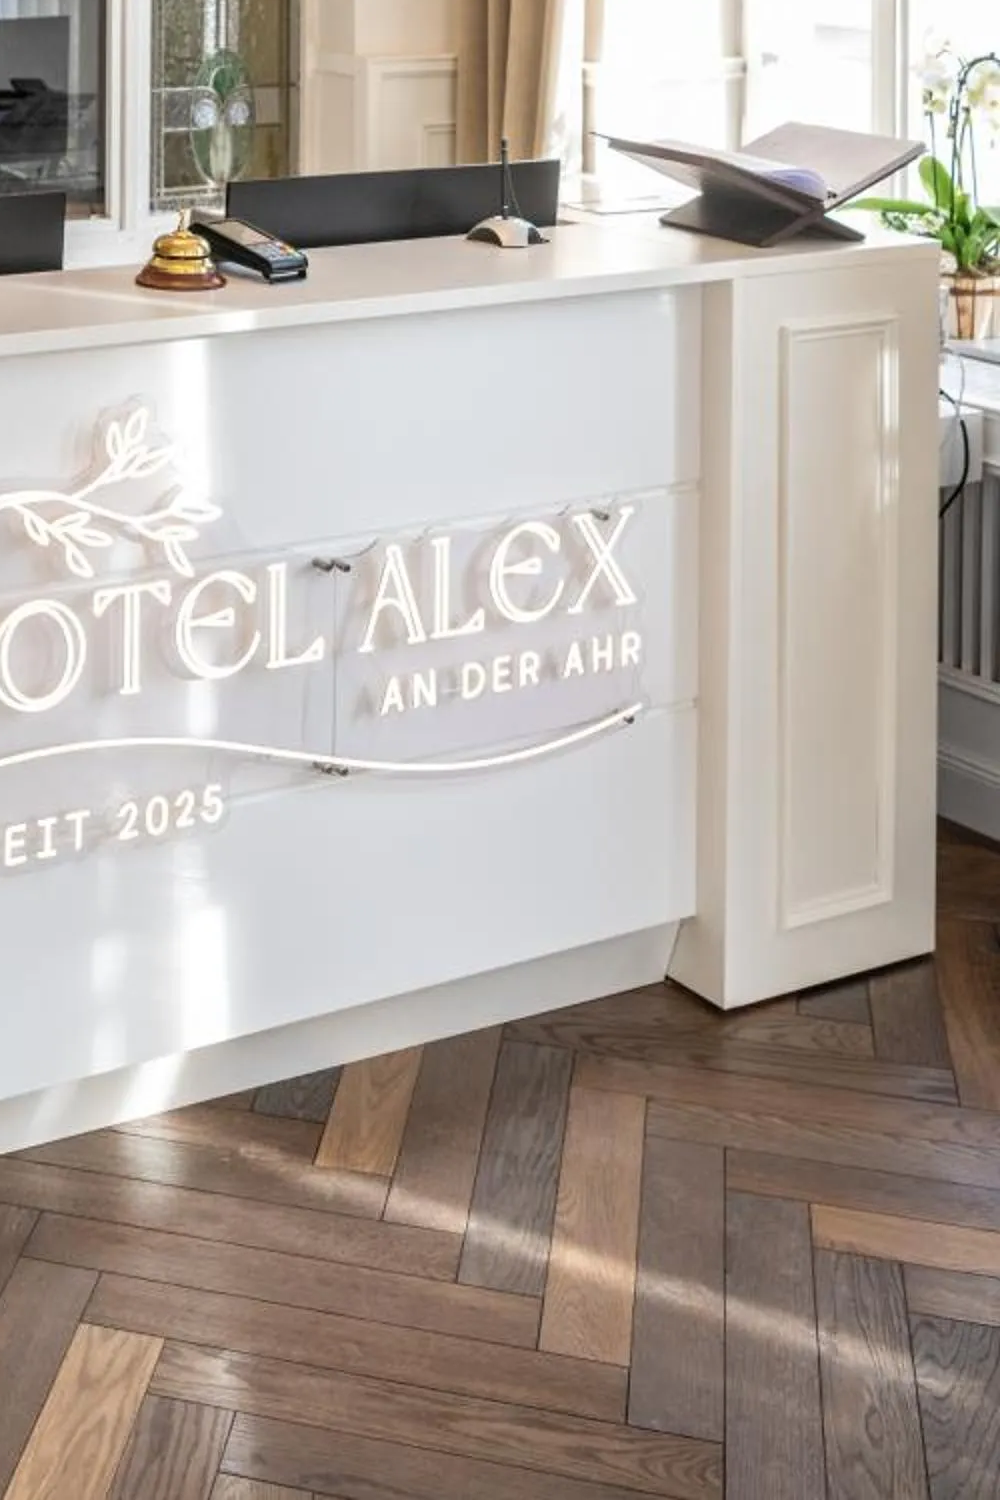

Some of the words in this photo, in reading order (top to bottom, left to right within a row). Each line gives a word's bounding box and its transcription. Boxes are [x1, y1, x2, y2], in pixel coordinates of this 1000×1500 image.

[360, 506, 637, 652] ALEX
[380, 666, 437, 715] AN
[461, 649, 540, 700] DER
[564, 632, 642, 679] AHR
[117, 783, 224, 842] 2025
